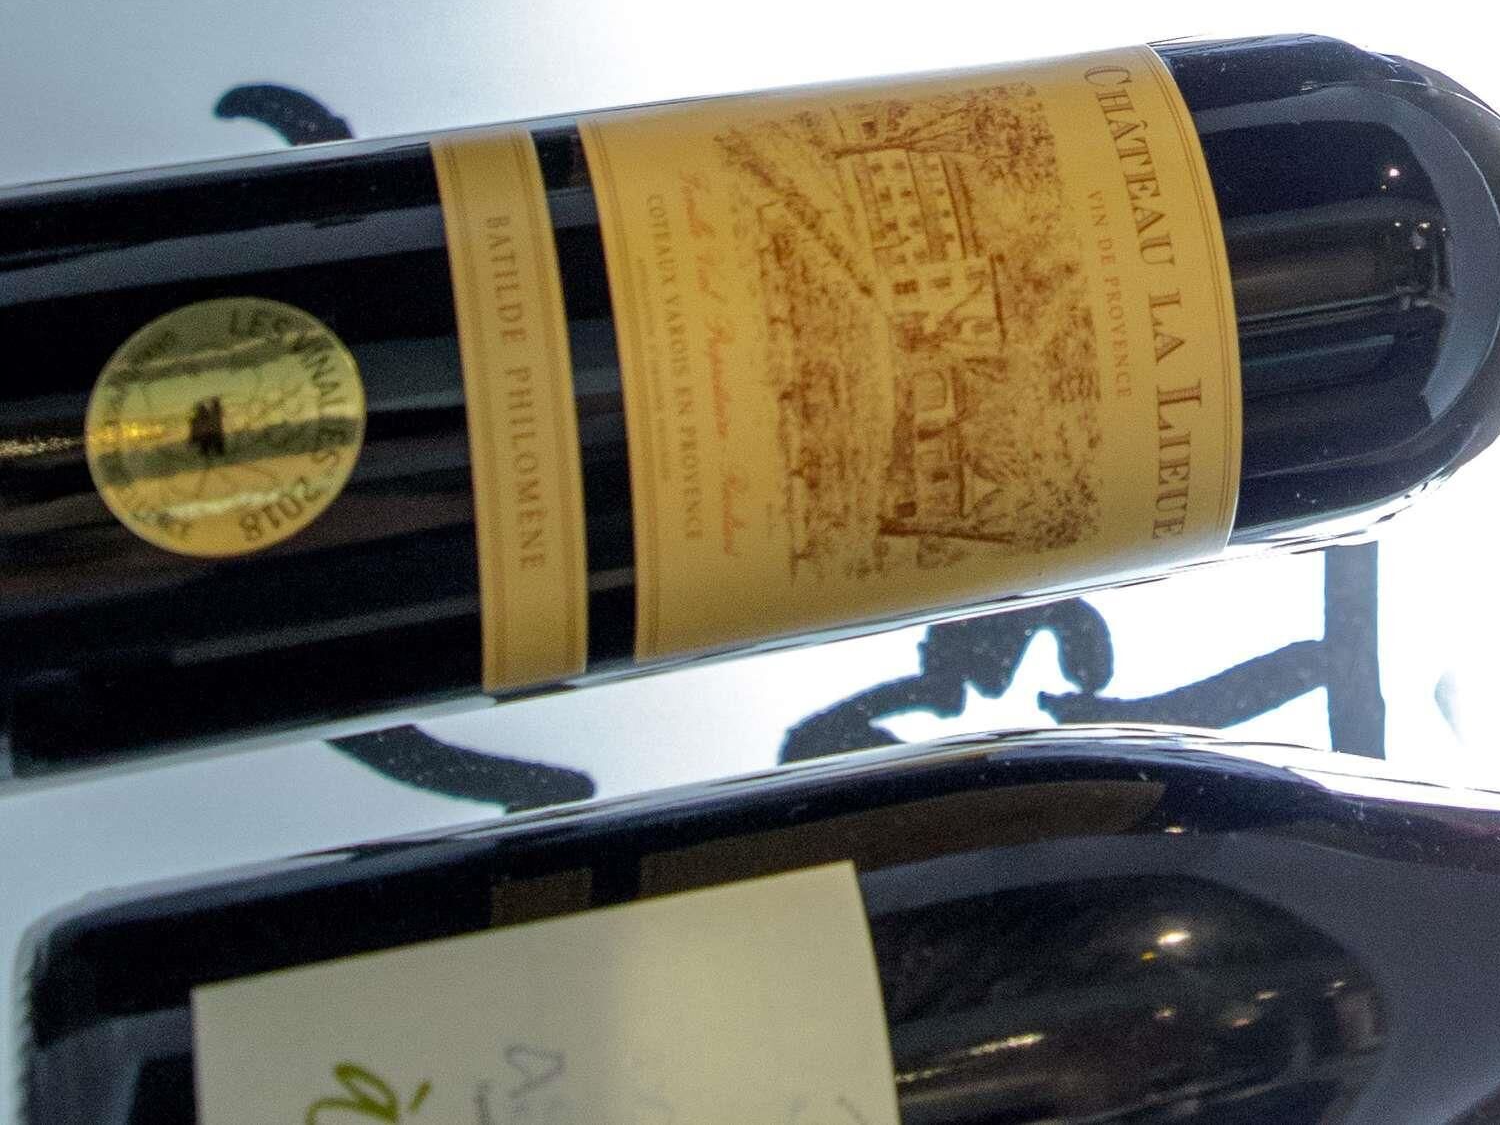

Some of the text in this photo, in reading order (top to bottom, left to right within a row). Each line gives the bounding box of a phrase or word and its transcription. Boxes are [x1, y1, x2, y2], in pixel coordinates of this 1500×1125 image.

[647, 192, 675, 287] COTEAUX
[1088, 188, 1133, 399] VIN DE PROVENCE
[664, 294, 691, 378] VAROIS
[1084, 65, 1202, 541] CHÂTEAU LA LIEUE
[486, 215, 548, 571] BATILDE PHILOMÈNE
[674, 385, 694, 416] EN
[680, 424, 703, 541] PROVENCE
